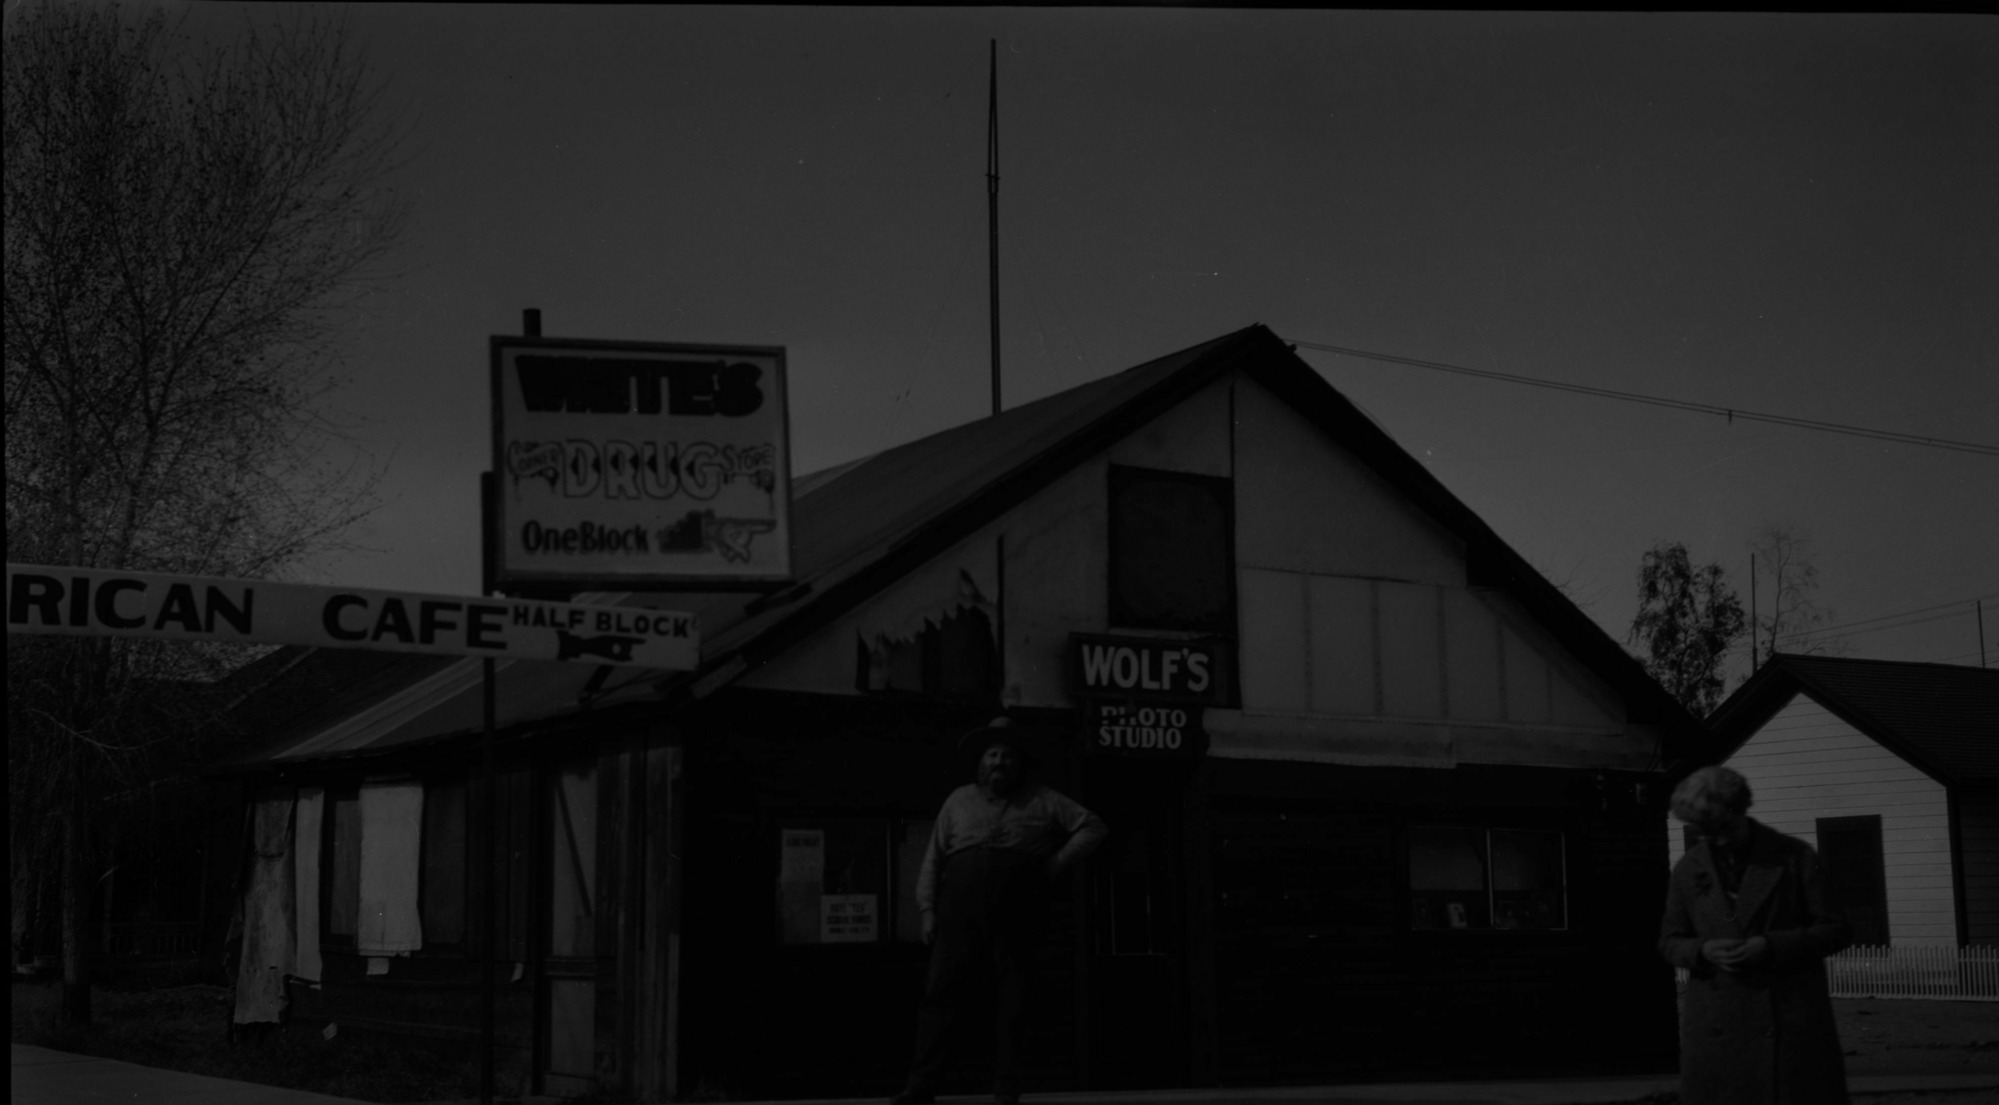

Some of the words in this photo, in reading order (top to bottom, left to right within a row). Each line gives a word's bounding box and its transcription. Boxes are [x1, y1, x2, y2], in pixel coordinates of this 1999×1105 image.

[562, 439, 722, 500] DRUG
[721, 443, 772, 473] STORE
[322, 594, 508, 650] CAFE
[513, 605, 585, 629] HALF
[596, 612, 690, 638] BLOCK
[1081, 643, 1210, 693] WOLF'S
[1099, 725, 1183, 750] STUDIO
